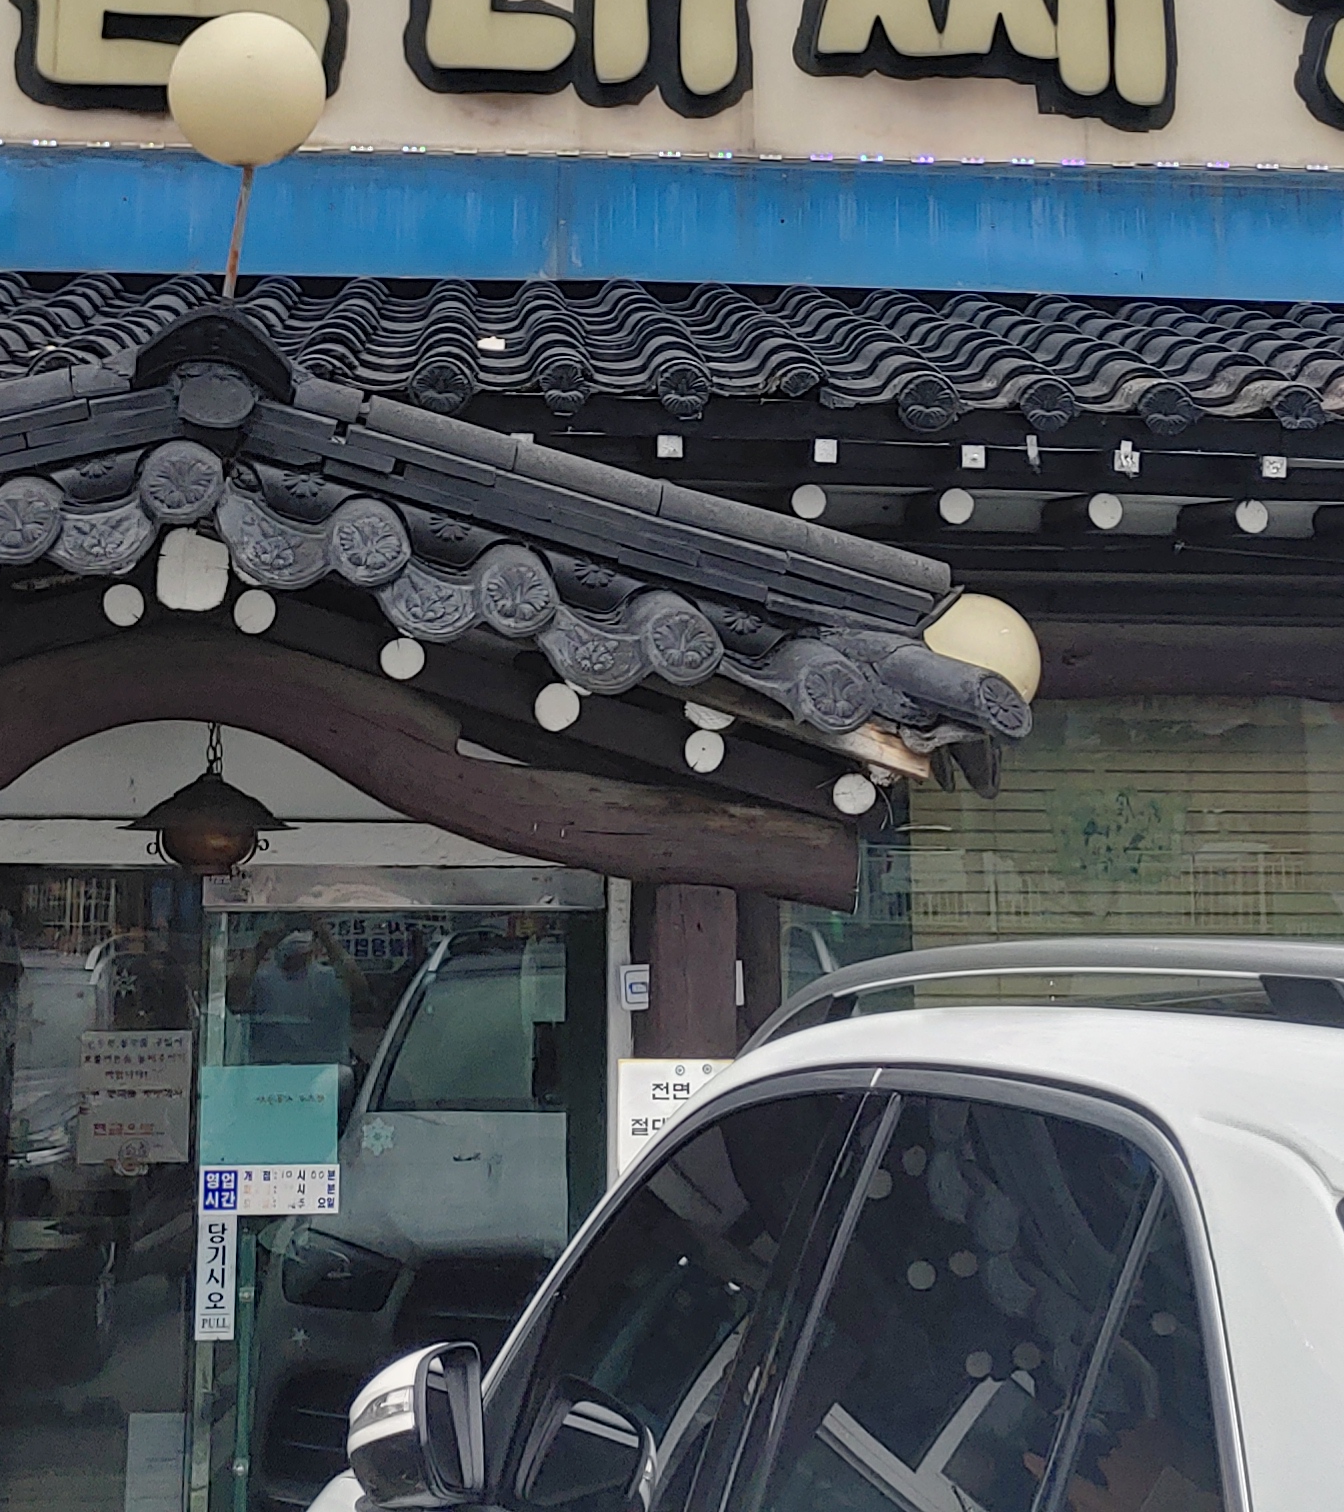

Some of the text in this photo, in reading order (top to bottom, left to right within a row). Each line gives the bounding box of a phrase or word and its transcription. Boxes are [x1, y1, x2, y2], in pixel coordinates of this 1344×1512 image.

[652, 1082, 690, 1100] 전면
[206, 1172, 235, 1189] 영업
[205, 1191, 236, 1208] 시간
[205, 1222, 228, 1310] 당기시오
[201, 1317, 230, 1329] PULL
